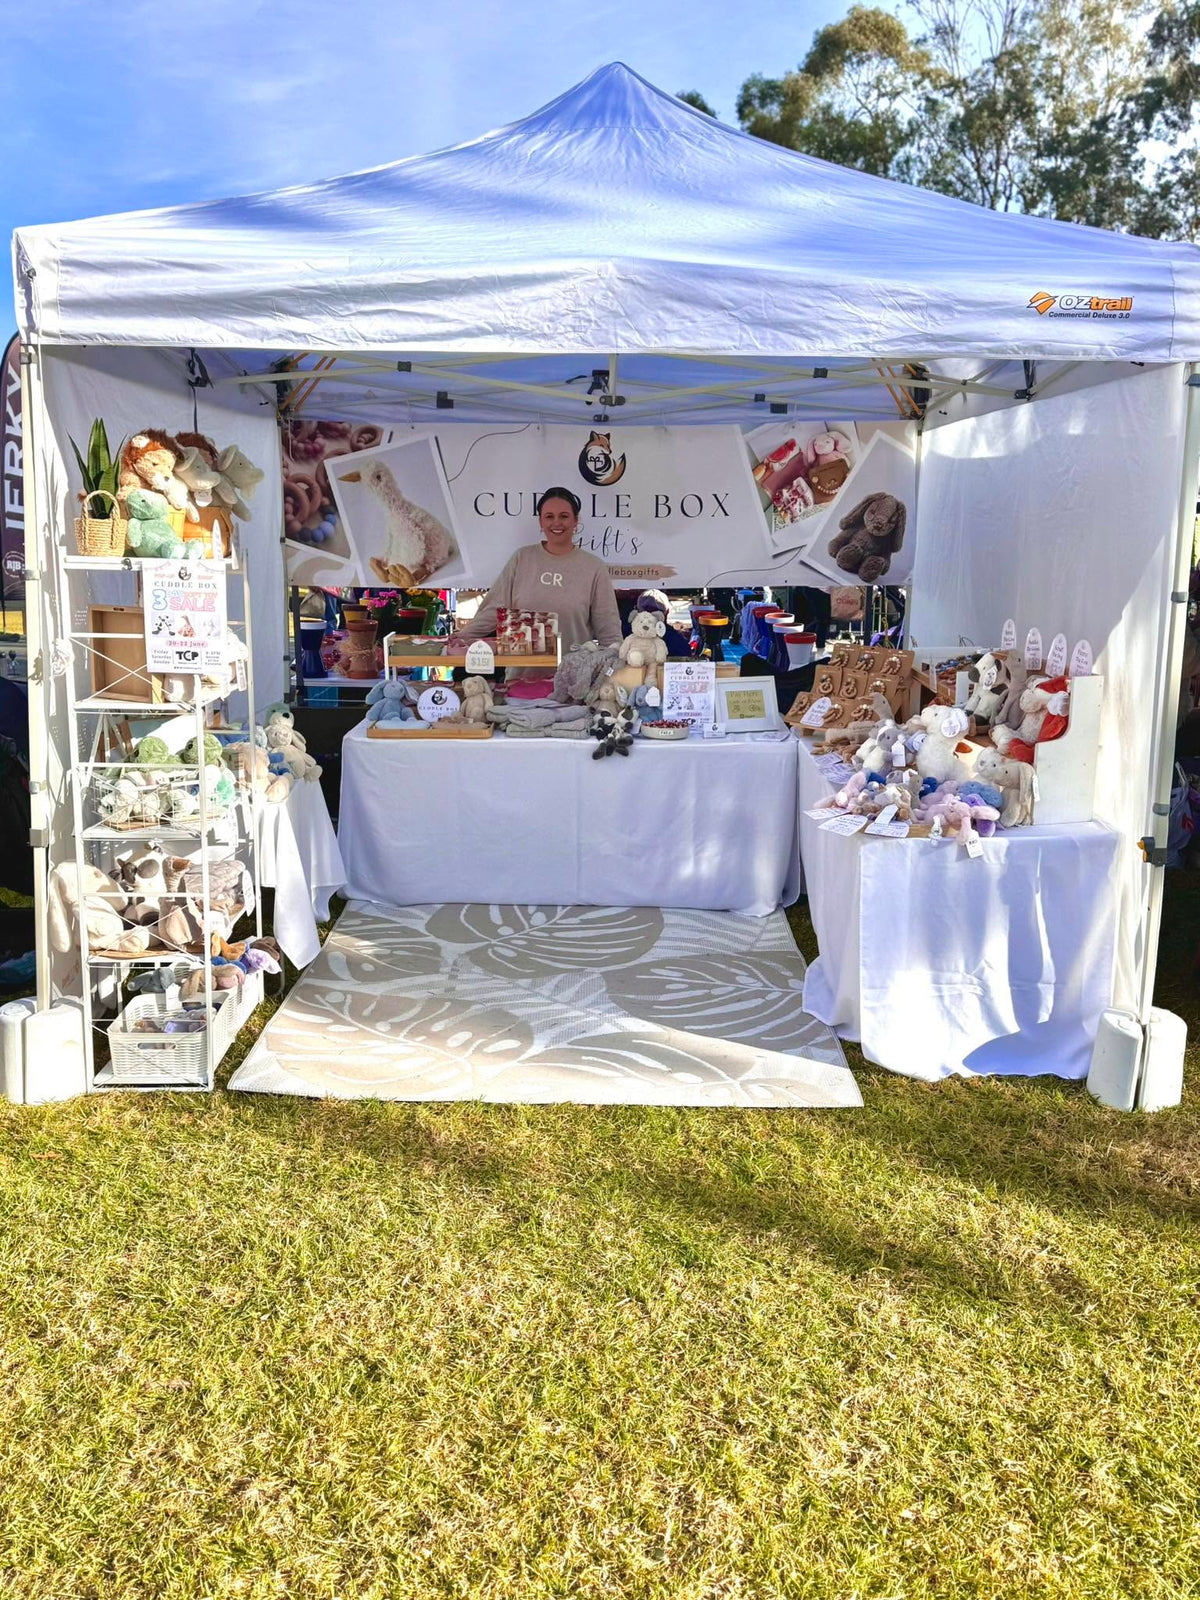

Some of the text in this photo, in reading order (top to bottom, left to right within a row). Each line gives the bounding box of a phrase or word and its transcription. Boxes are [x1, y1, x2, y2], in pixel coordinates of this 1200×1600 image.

[1060, 295, 1133, 311] OZtrail
[1049, 311, 1091, 319] Commercial
[1092, 311, 1117, 319] Deluxe
[654, 492, 730, 518] BOX
[154, 581, 194, 589] CUDDLE
[540, 571, 563, 587] CR
[152, 588, 168, 611] 3
[169, 597, 216, 612] SALE
[175, 650, 199, 661] TCP
